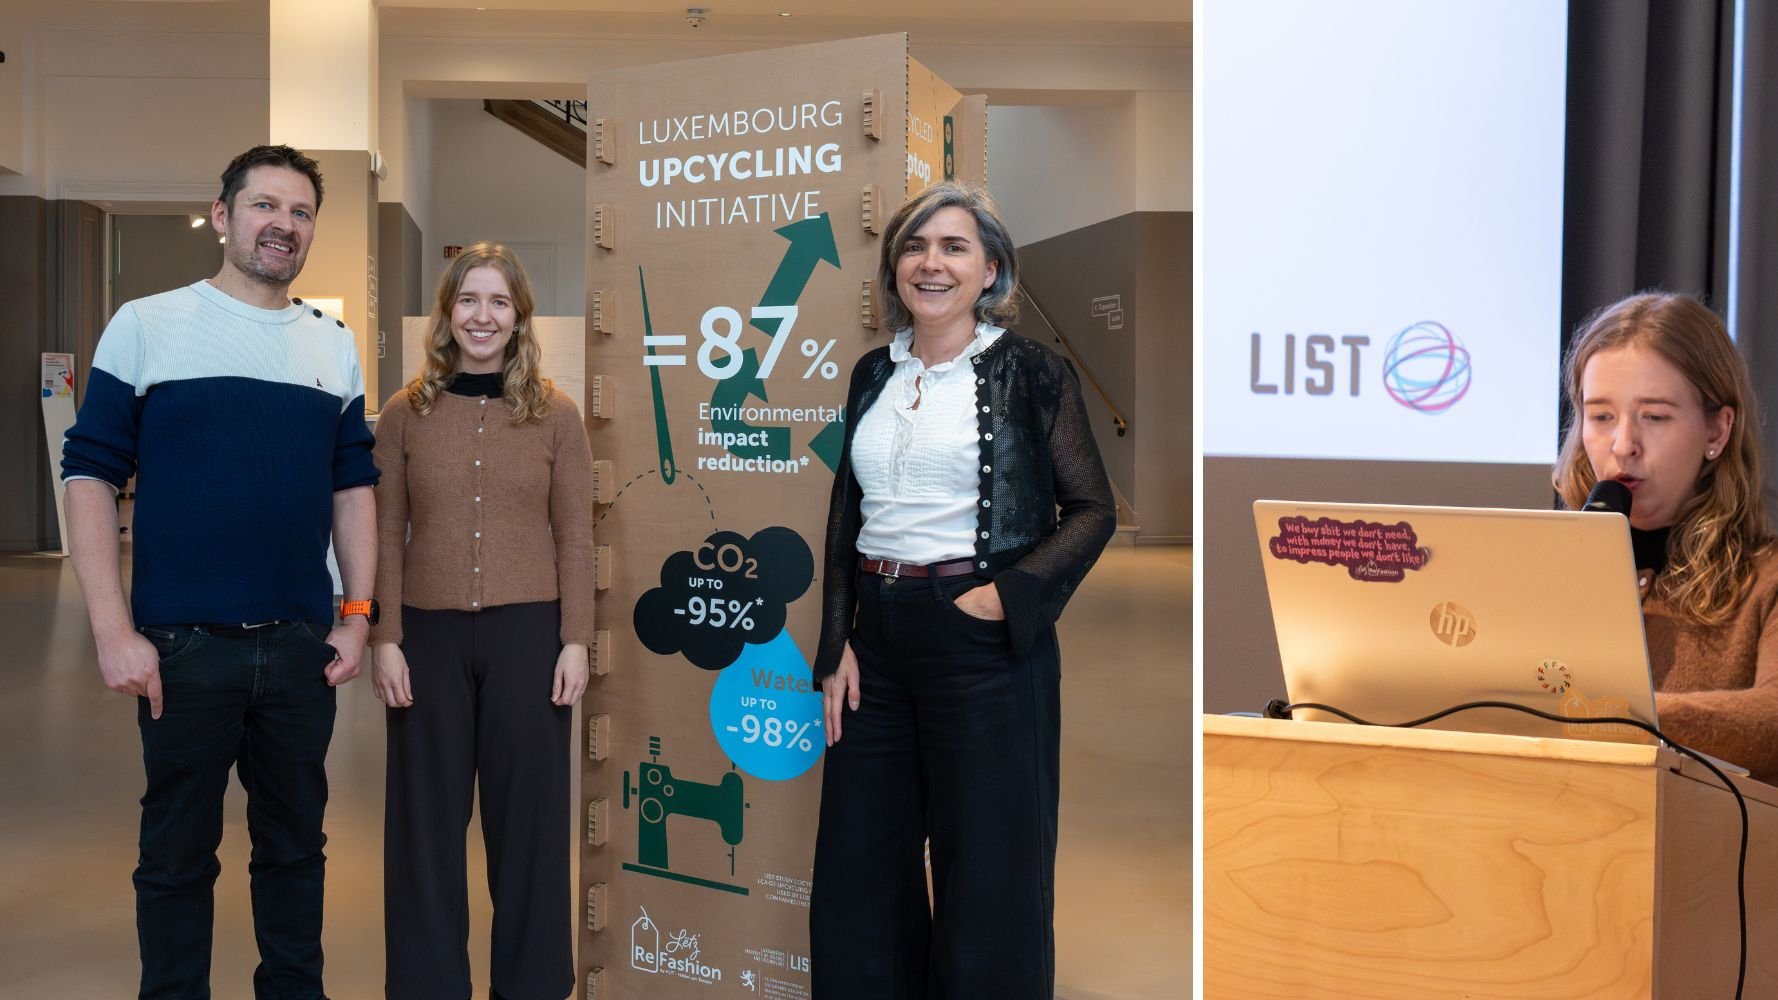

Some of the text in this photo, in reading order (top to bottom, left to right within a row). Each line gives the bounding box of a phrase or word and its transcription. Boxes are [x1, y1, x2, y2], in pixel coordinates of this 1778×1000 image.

[639, 101, 843, 145] LUXEMBOURG
[639, 143, 841, 187] UPCYCLING
[656, 190, 821, 229] INITIATIVE
[1250, 332, 1370, 397] LIST
[698, 402, 844, 423] Environmental
[698, 428, 769, 450] impact
[1285, 523, 1300, 533] We
[1301, 524, 1318, 537] buy
[1321, 525, 1341, 537] shit
[1343, 529, 1356, 538] we
[1358, 527, 1382, 540] don't
[1286, 535, 1309, 546] with
[1311, 537, 1341, 549] money
[1343, 539, 1357, 548] we
[1357, 538, 1382, 550] don't
[1276, 544, 1287, 553] to
[1289, 545, 1327, 558] impress
[1329, 549, 1360, 561] people
[1361, 550, 1375, 559] we
[1376, 552, 1401, 563] don't
[688, 577, 723, 590] UP TO
[1437, 601, 1470, 648] hp
[751, 668, 814, 694] Wate
[741, 696, 777, 710] UP TO
[635, 945, 655, 964] Re
[660, 951, 722, 981] Fashion
[791, 954, 811, 973] LIS
